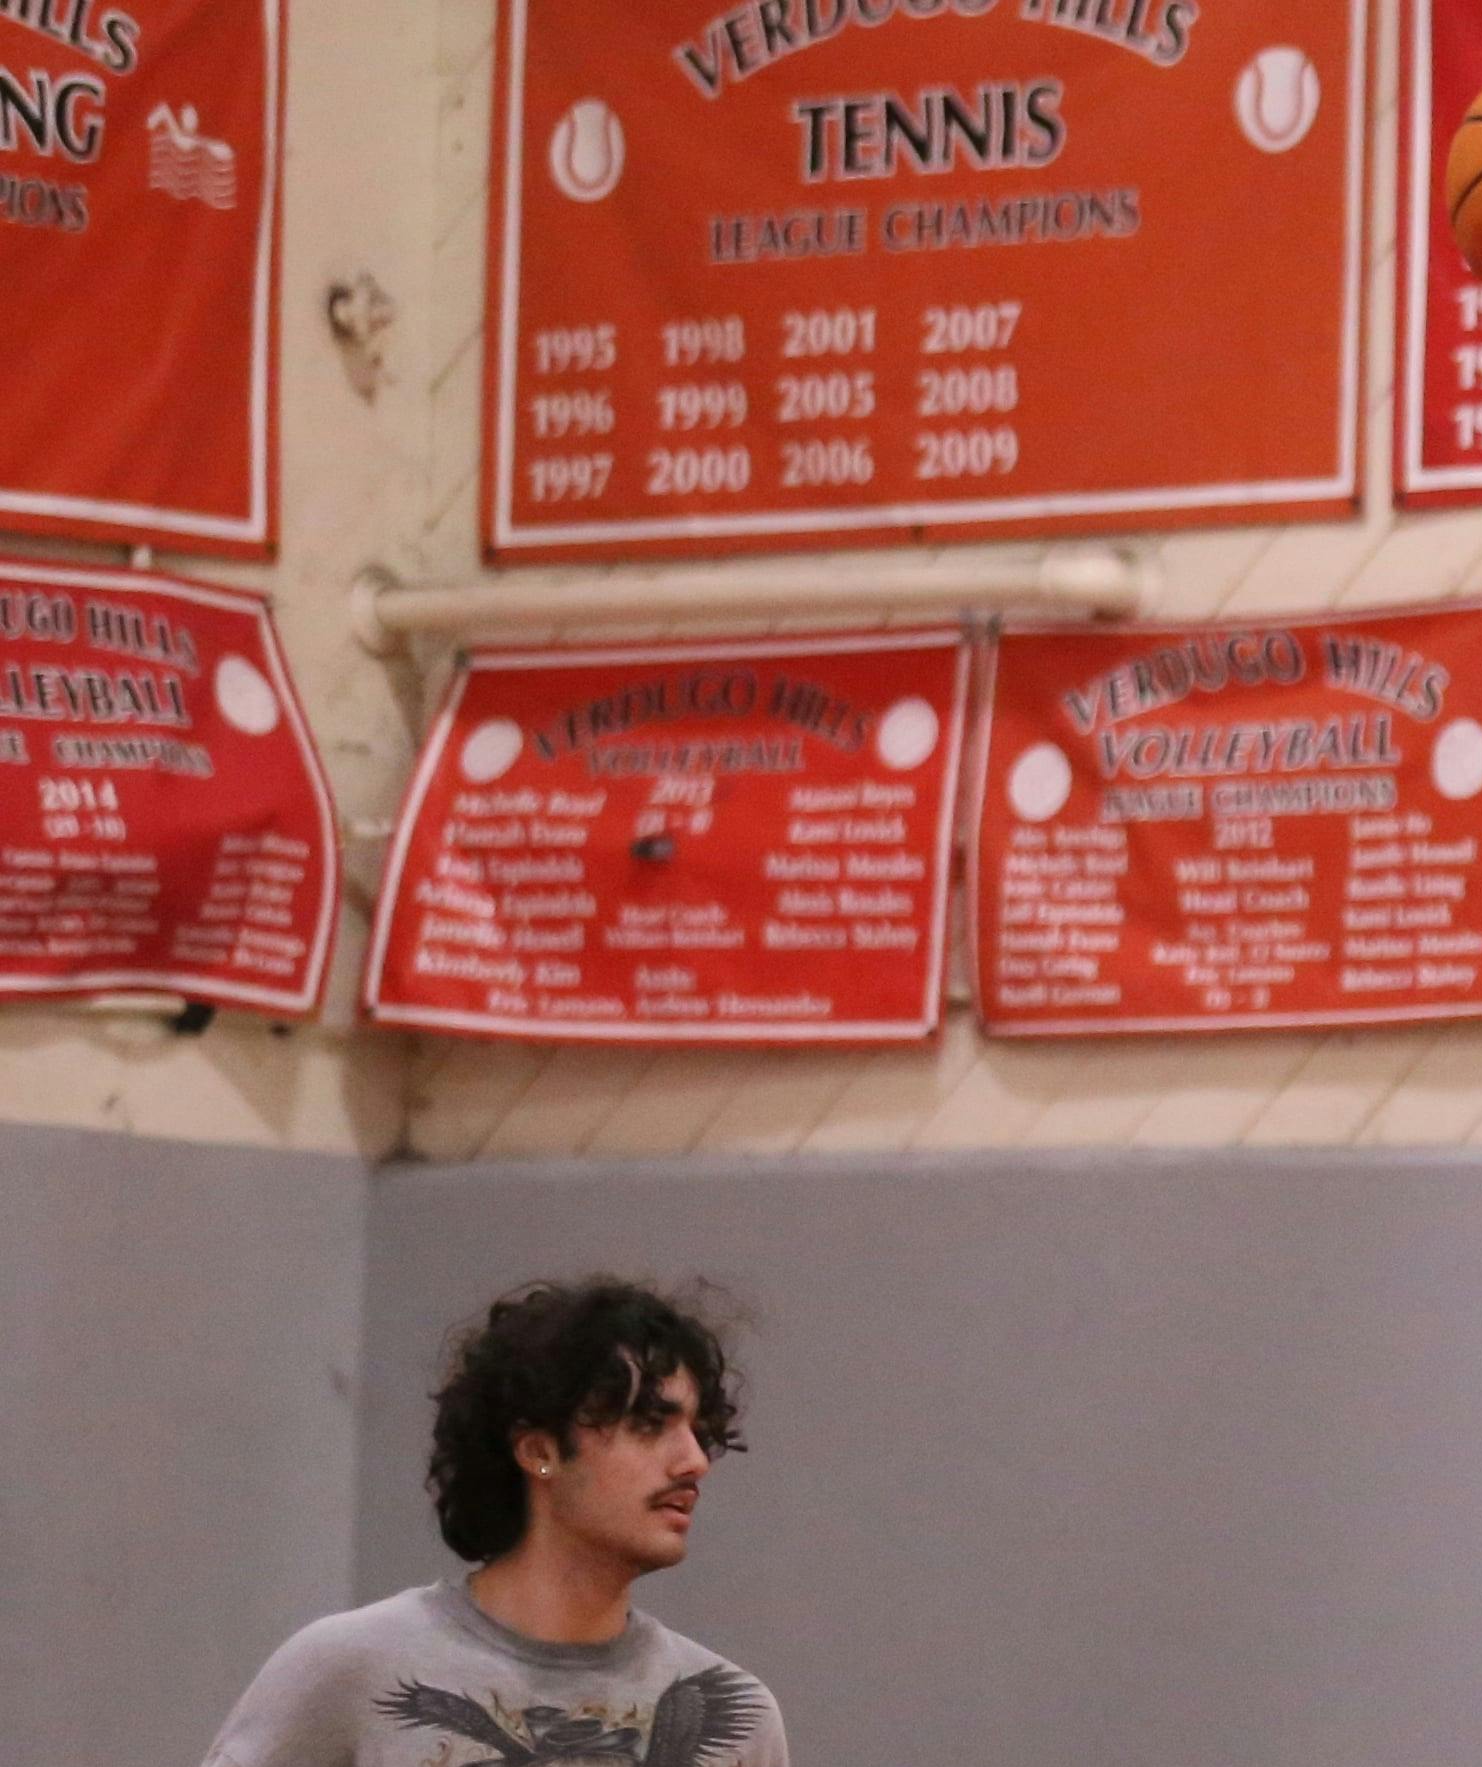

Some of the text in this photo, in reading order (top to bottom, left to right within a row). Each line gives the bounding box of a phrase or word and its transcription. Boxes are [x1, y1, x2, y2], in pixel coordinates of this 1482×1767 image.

[791, 72, 1067, 182] TENNIS
[708, 185, 1142, 263] LEAGUE CHAMPIONS
[533, 322, 617, 376] 1995
[780, 306, 877, 358] 2001
[920, 299, 1022, 355] 2007
[656, 380, 749, 431] 1999
[915, 364, 1020, 417] 2008
[526, 425, 1020, 503] 1997 2000 2006 2009
[1062, 628, 1452, 736] VERDUGO HILLS
[1097, 711, 1403, 781] VOLLEYBALL
[1209, 771, 1399, 817] CHAMPIONS
